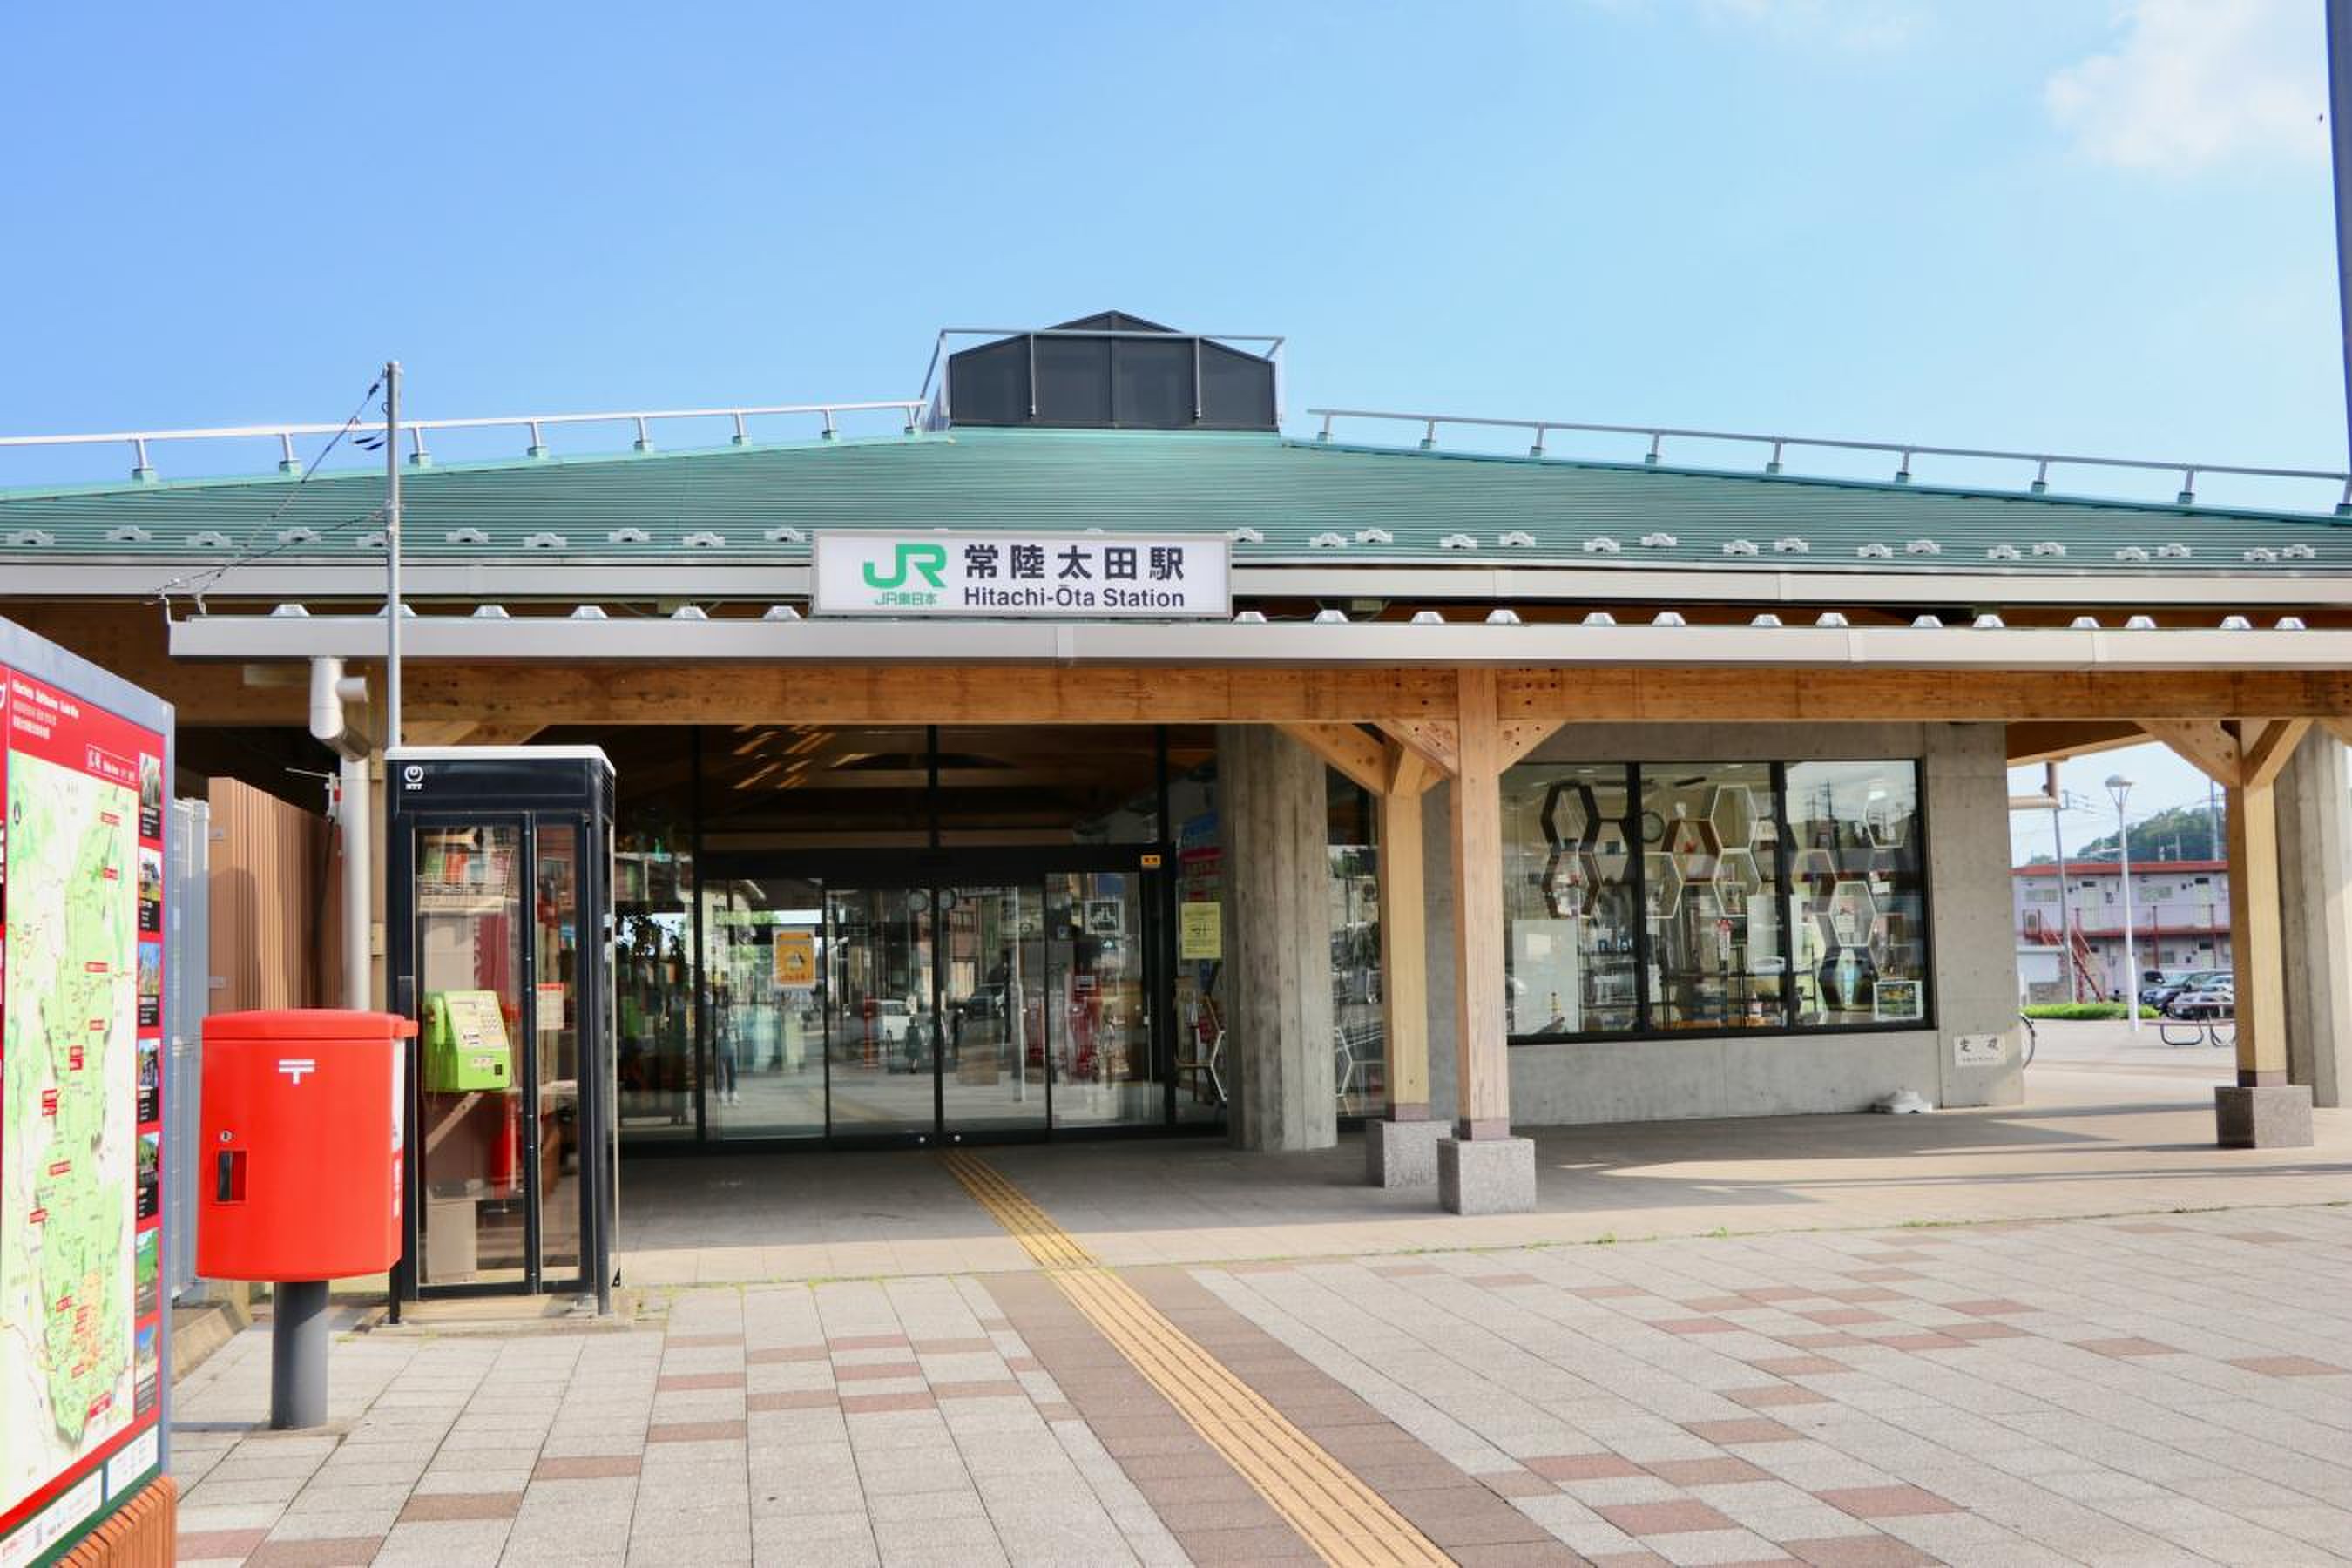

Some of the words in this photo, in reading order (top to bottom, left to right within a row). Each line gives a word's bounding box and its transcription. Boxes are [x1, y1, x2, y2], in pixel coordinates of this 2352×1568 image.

[862, 543, 947, 589] JR
[964, 544, 1185, 581] 常陸太田駅
[963, 585, 1095, 607] Hitachi-Ōta
[1103, 587, 1185, 608] Station
